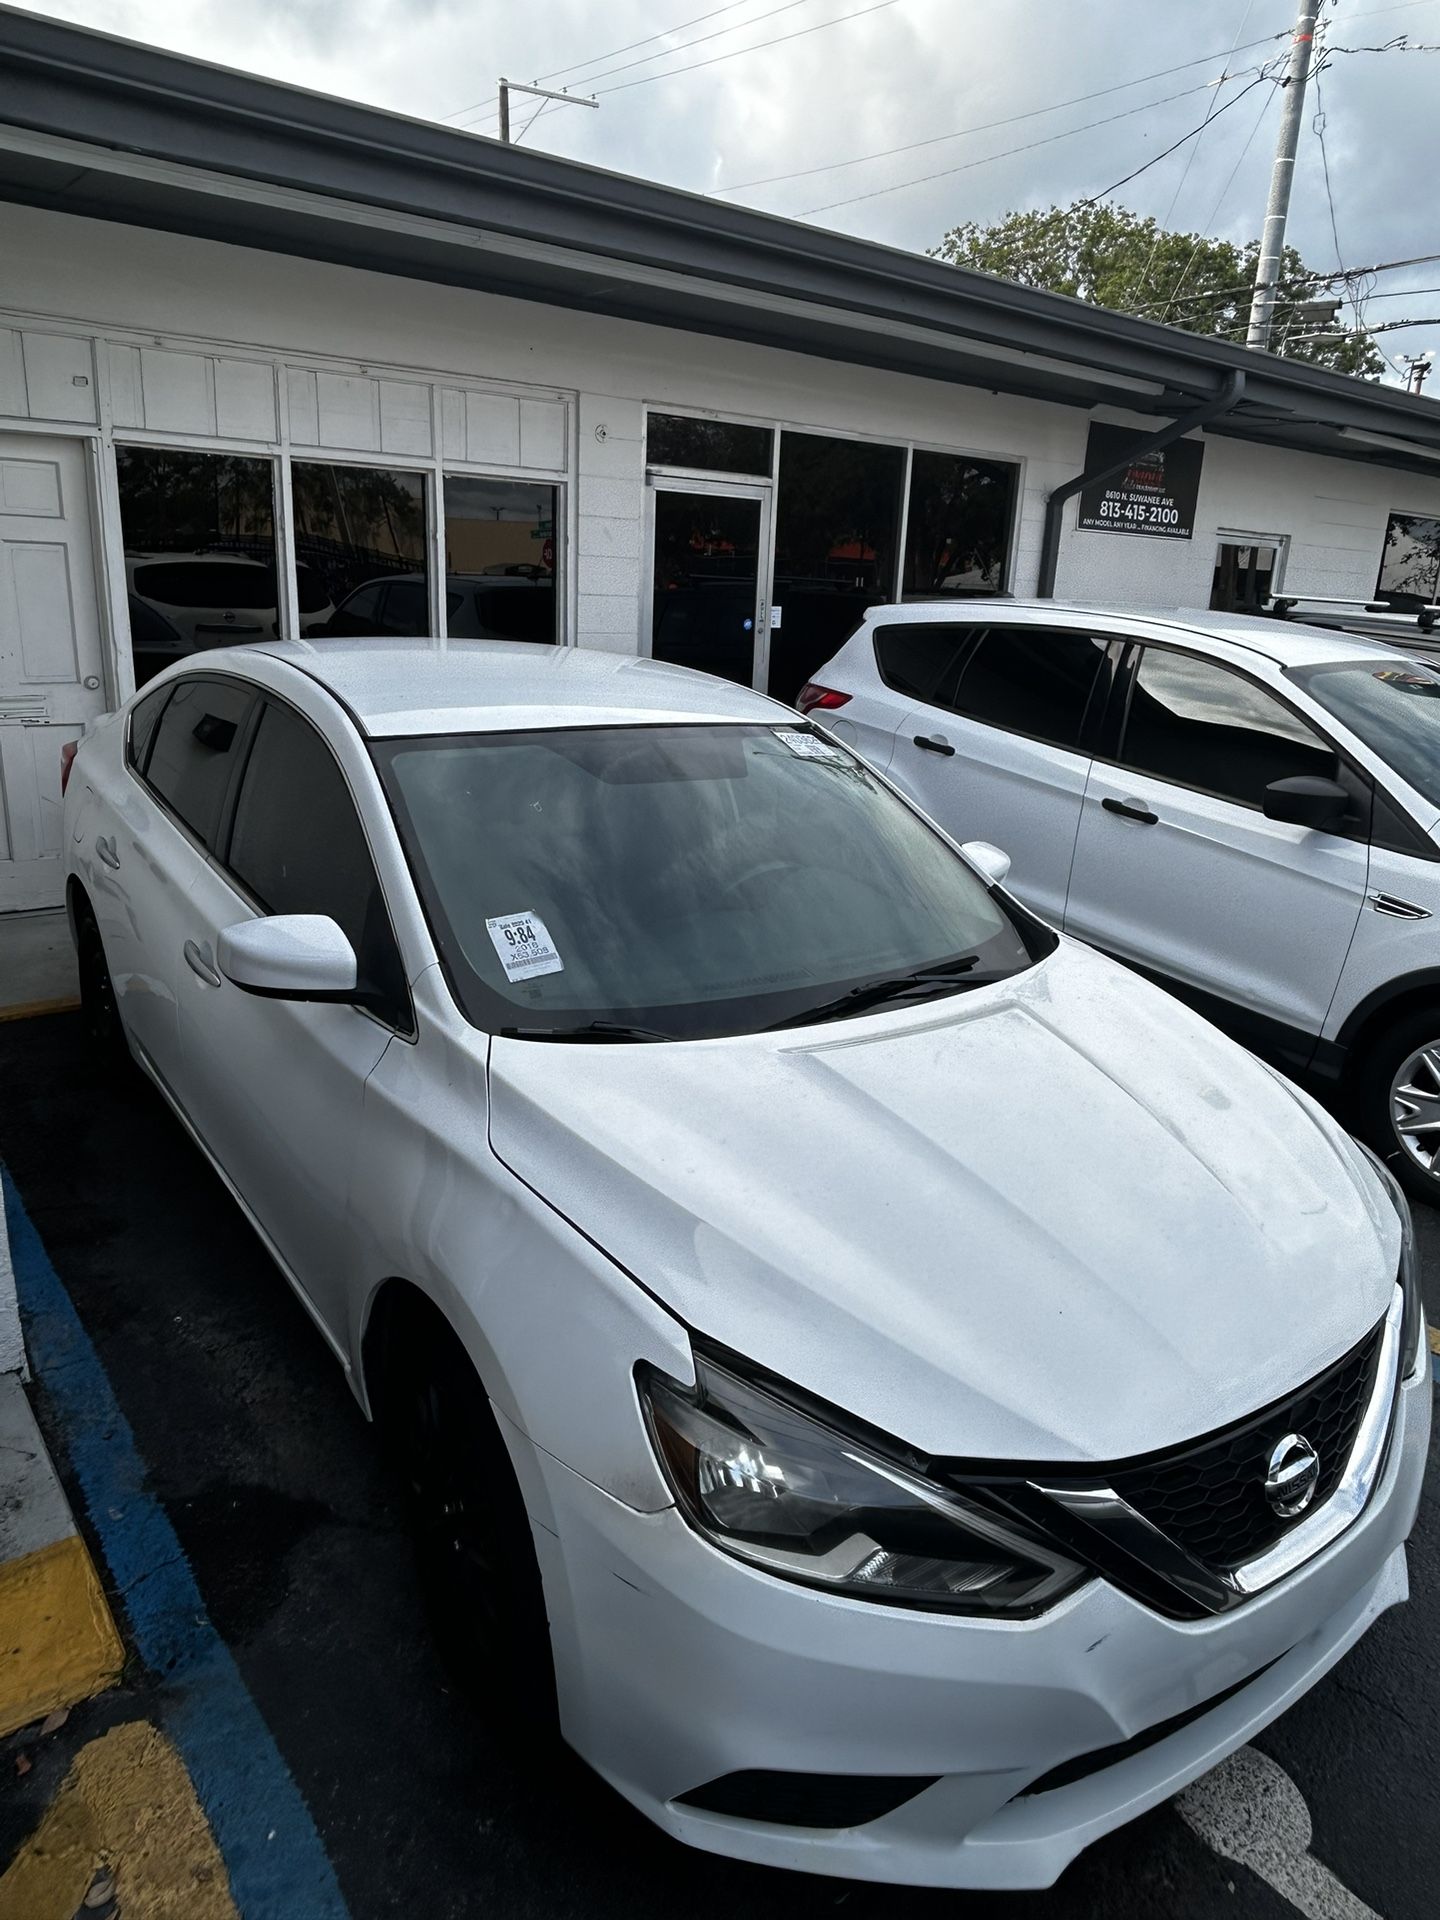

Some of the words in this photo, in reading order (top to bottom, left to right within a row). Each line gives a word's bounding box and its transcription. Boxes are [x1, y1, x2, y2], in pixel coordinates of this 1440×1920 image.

[1105, 490, 1121, 499] 8610
[1129, 493, 1160, 505] SUWANEE
[1160, 497, 1174, 507] AVE
[1100, 501, 1178, 524] 813-415-2100
[1083, 518, 1095, 526] ANY
[1095, 519, 1113, 528] MODEL
[1113, 520, 1123, 529] ANY
[1123, 521, 1137, 530] YEAR
[1141, 523, 1167, 534] FINANCING
[504, 925, 536, 946] 9:84
